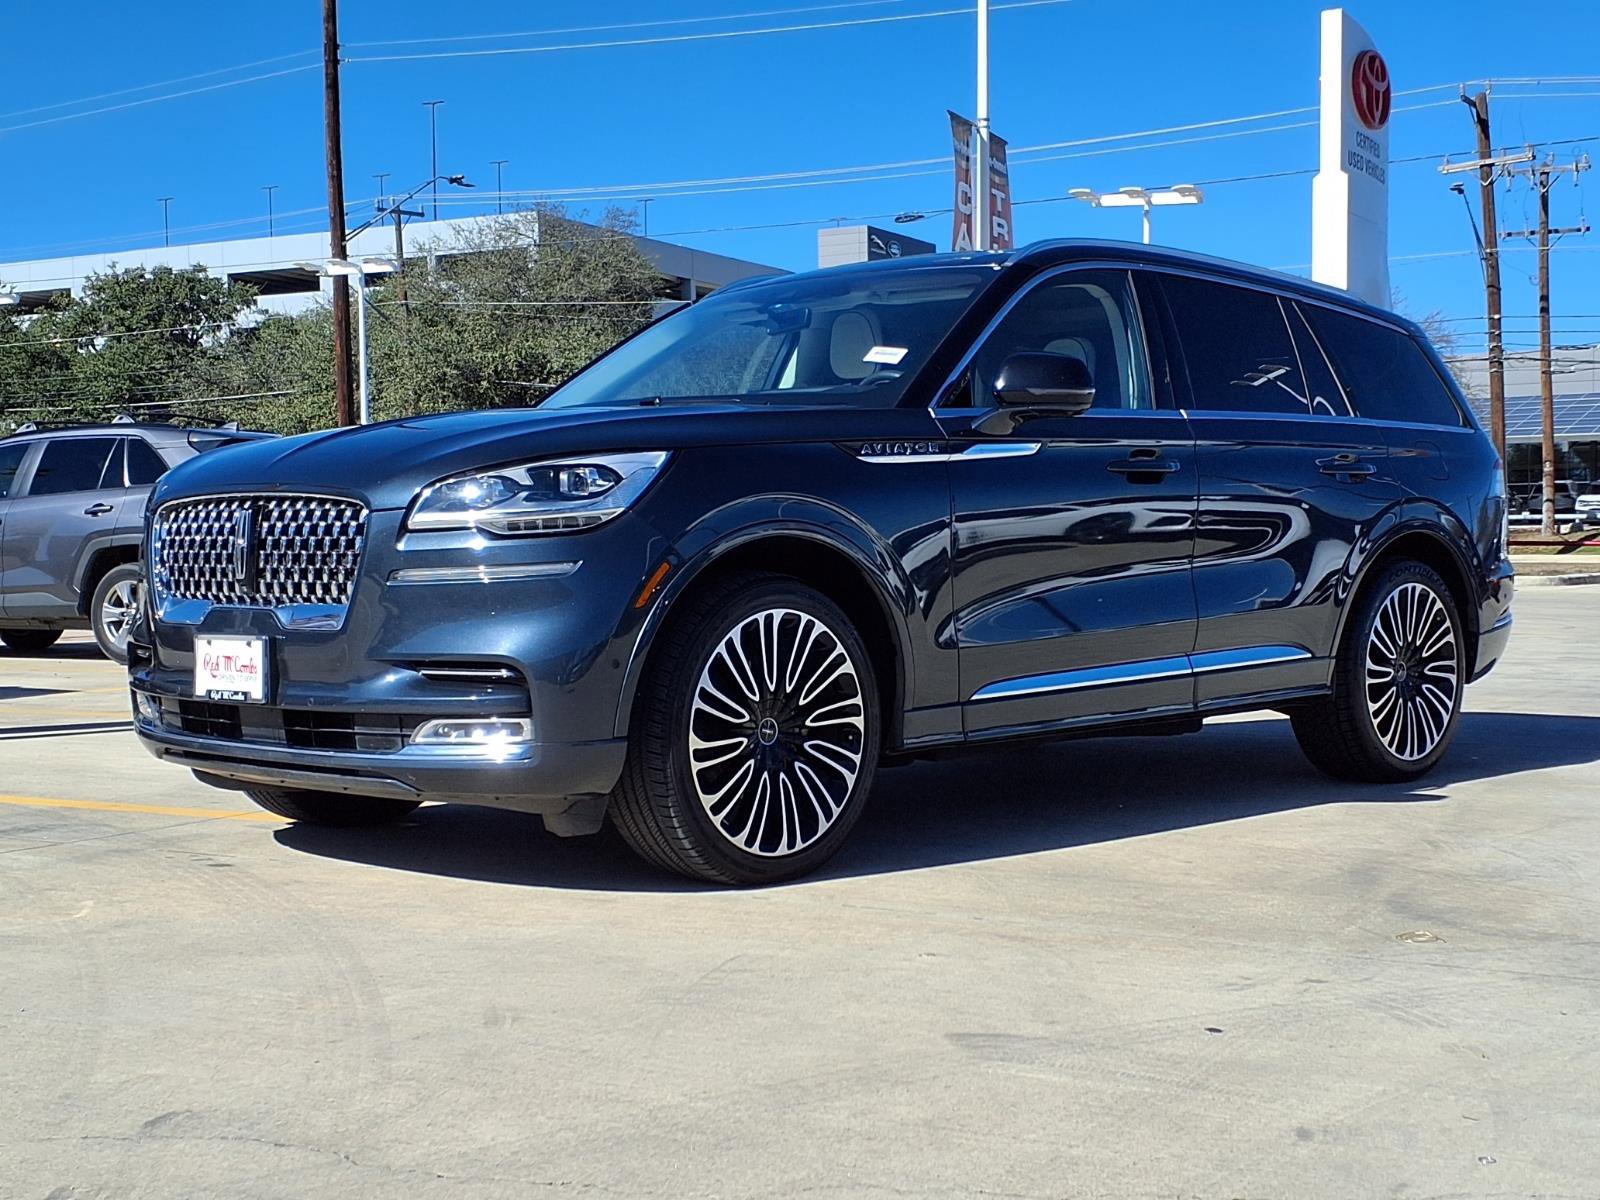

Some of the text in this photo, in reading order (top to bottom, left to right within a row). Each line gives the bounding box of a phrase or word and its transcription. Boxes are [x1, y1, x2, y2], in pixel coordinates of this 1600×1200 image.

[1356, 131, 1380, 159] CERTIFIED
[1347, 150, 1385, 185] USED VEHICLES
[861, 442, 939, 455] AVIATOR
[203, 653, 220, 678] Red
